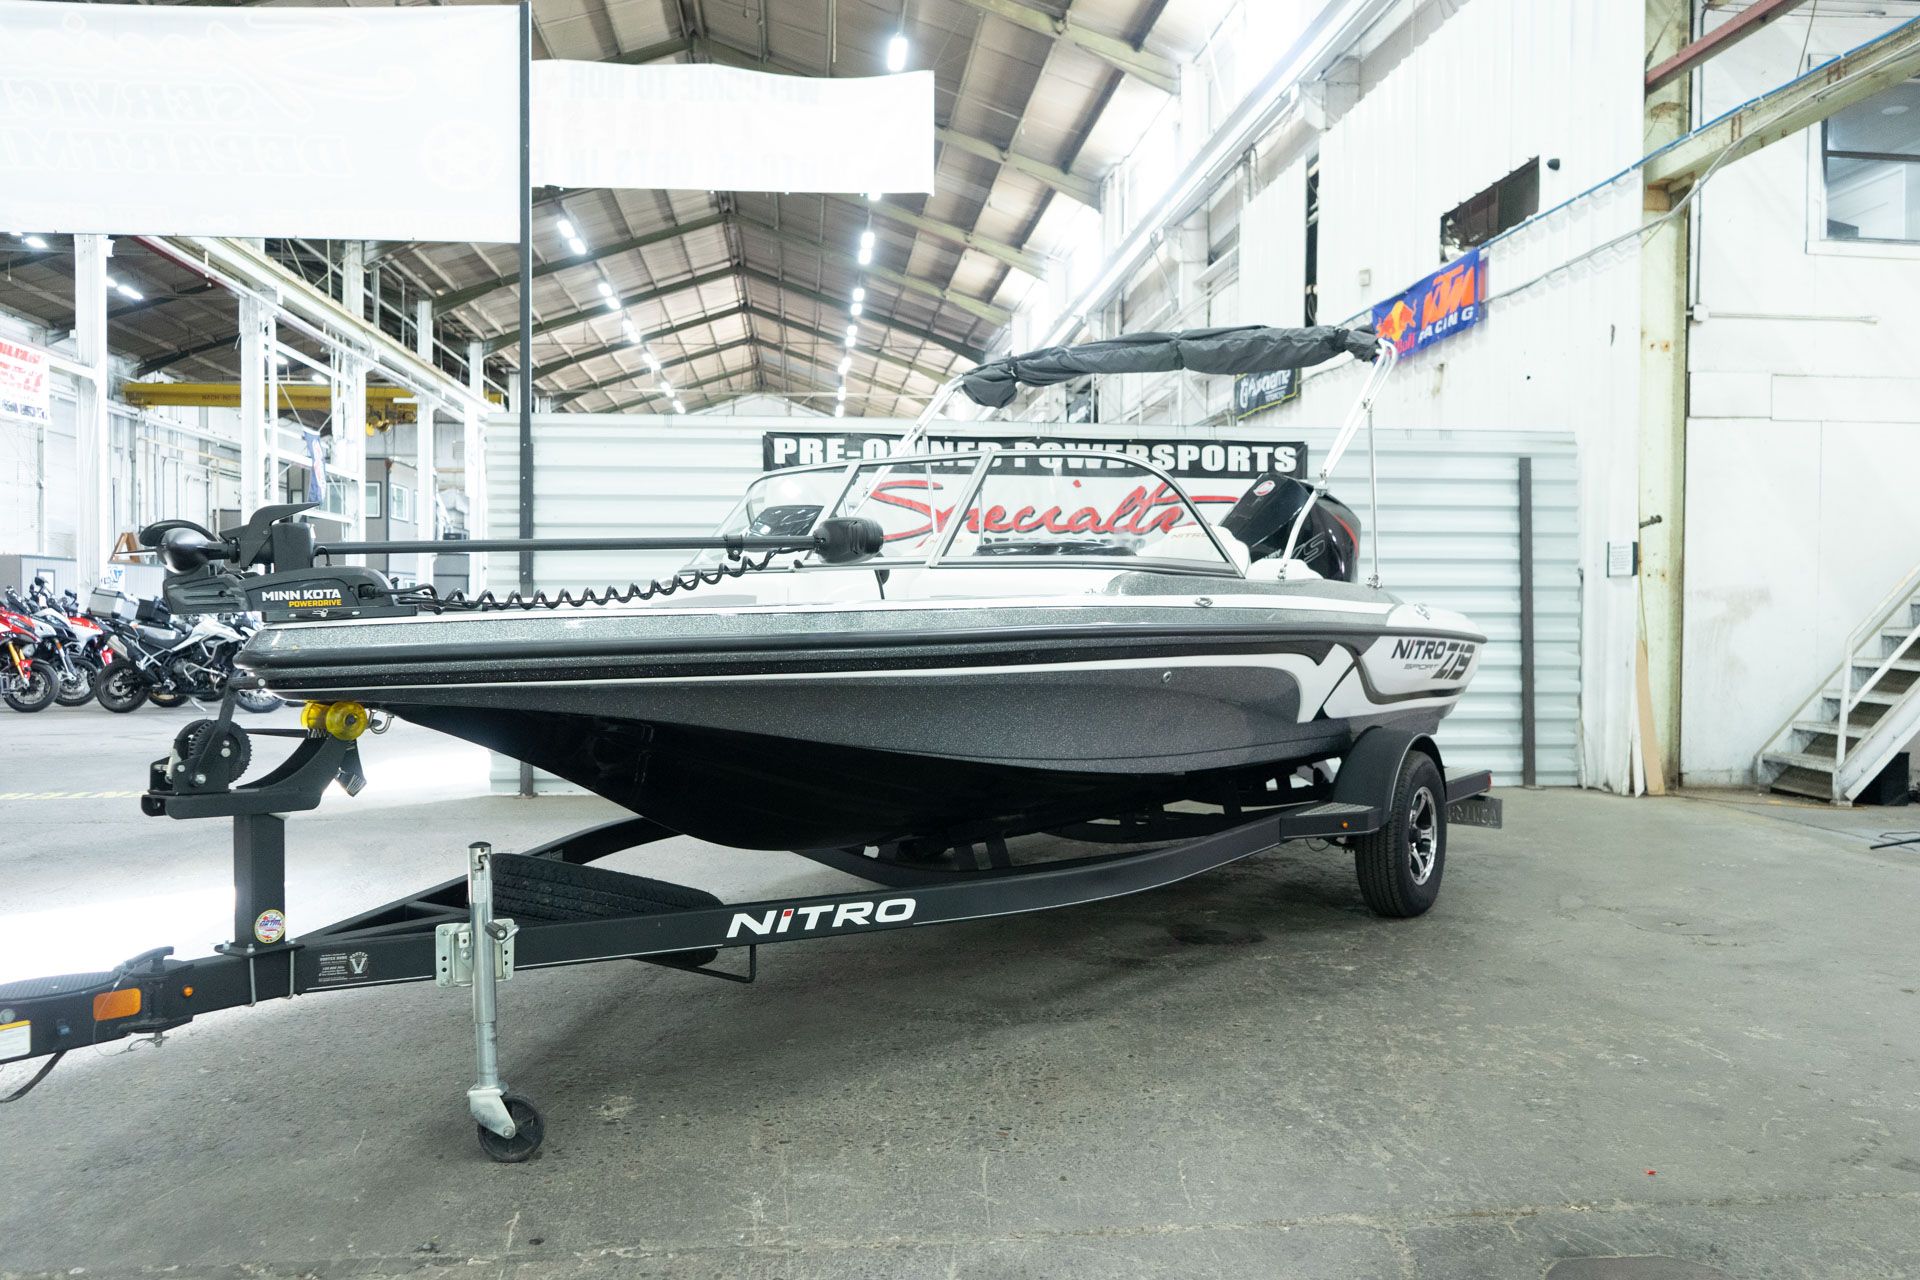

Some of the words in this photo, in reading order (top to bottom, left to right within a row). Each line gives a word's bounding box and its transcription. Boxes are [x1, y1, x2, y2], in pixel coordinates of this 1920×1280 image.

[1421, 264, 1475, 331] KTM
[1014, 442, 1297, 473] POWERSPORTS
[262, 590, 300, 601] MINN
[303, 589, 342, 599] KOTA
[288, 599, 342, 607] POWERDRIVE
[1391, 638, 1447, 660] NITRO
[726, 898, 917, 939] NITRO
